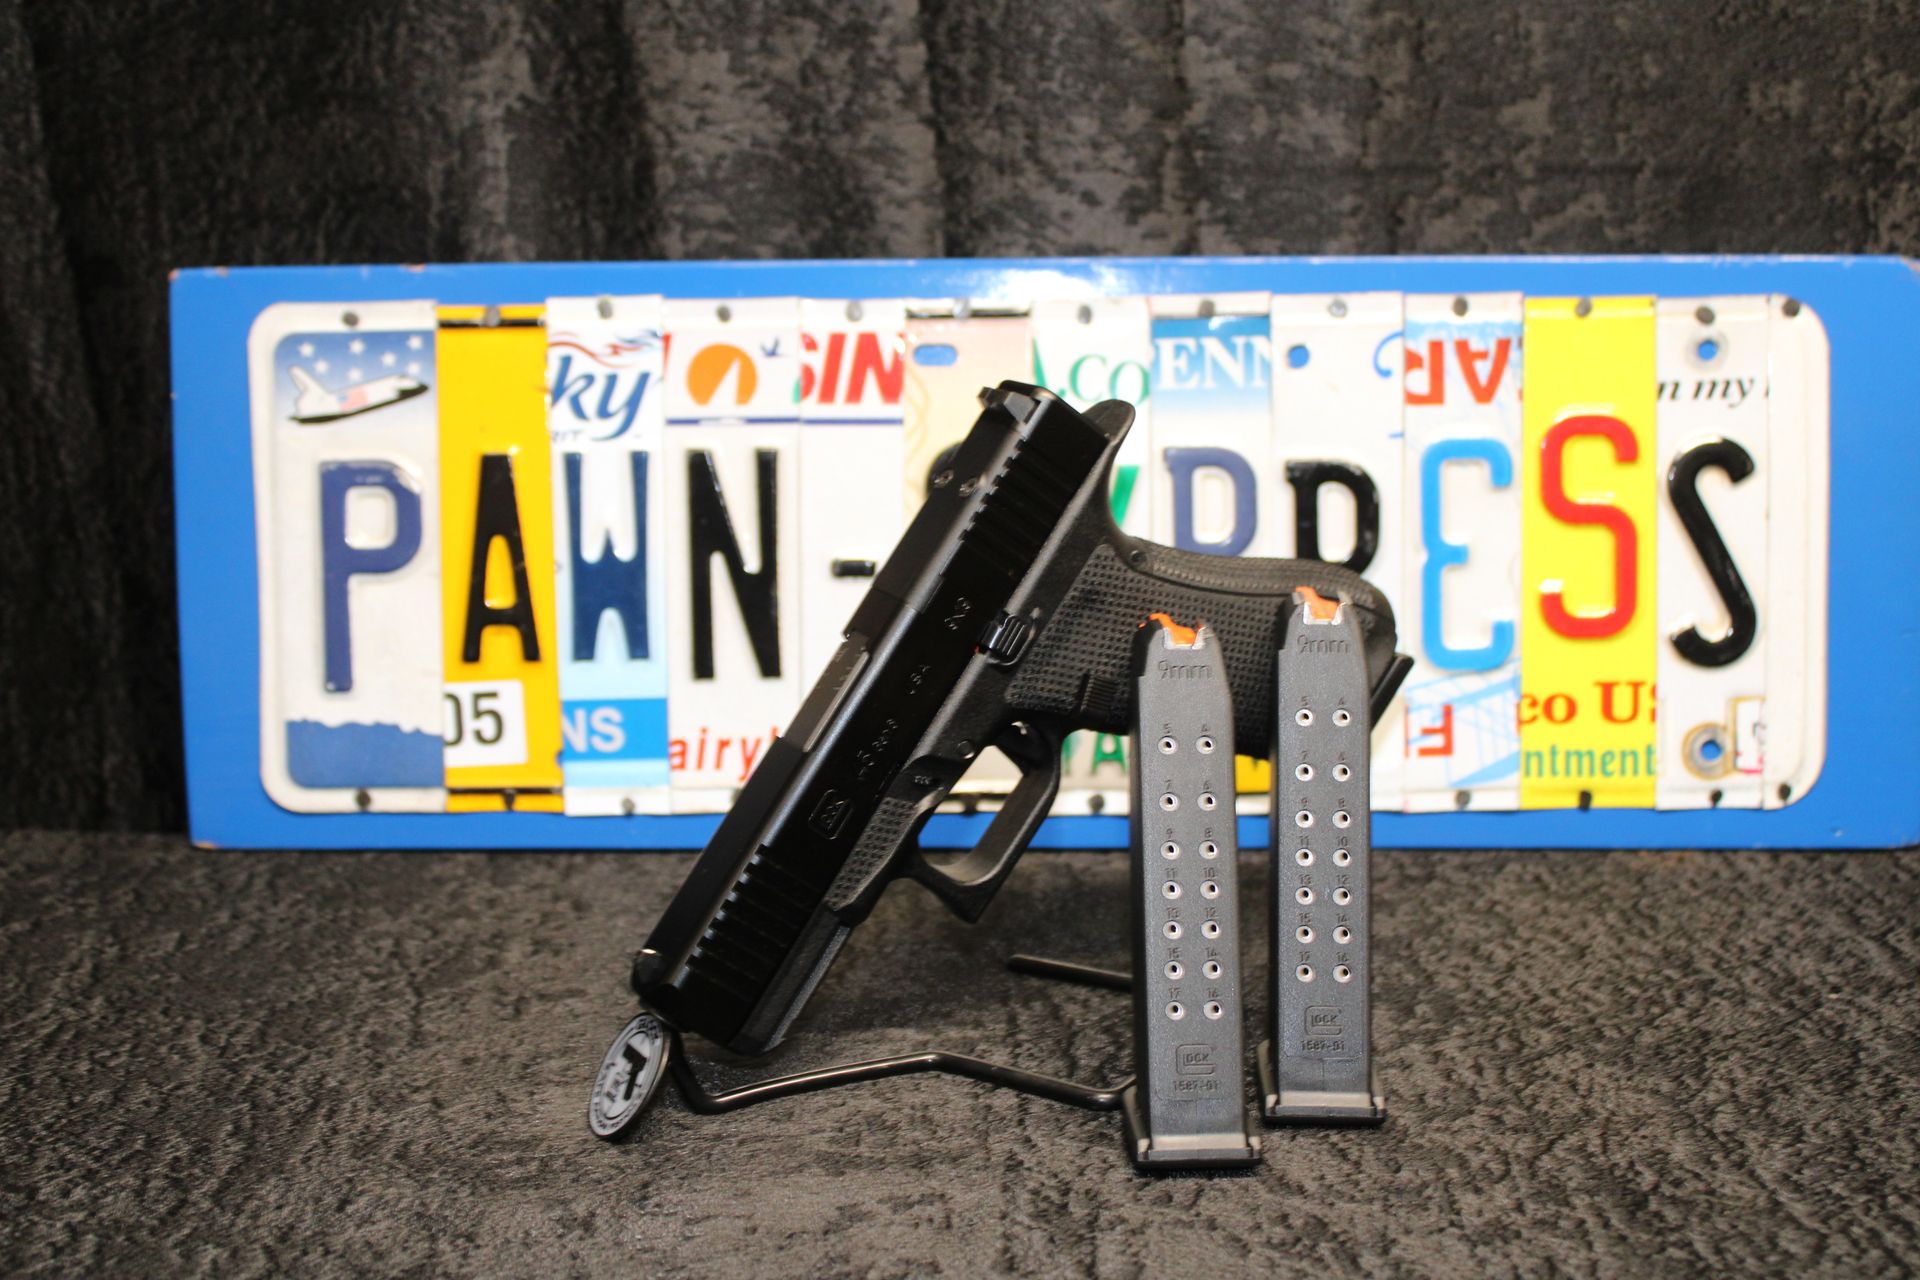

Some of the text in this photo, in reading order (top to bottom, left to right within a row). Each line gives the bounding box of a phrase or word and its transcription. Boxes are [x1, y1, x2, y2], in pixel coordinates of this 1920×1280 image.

[1693, 377, 1754, 408] my
[1297, 634, 1348, 655] 9mm
[1158, 660, 1211, 680] 9mm
